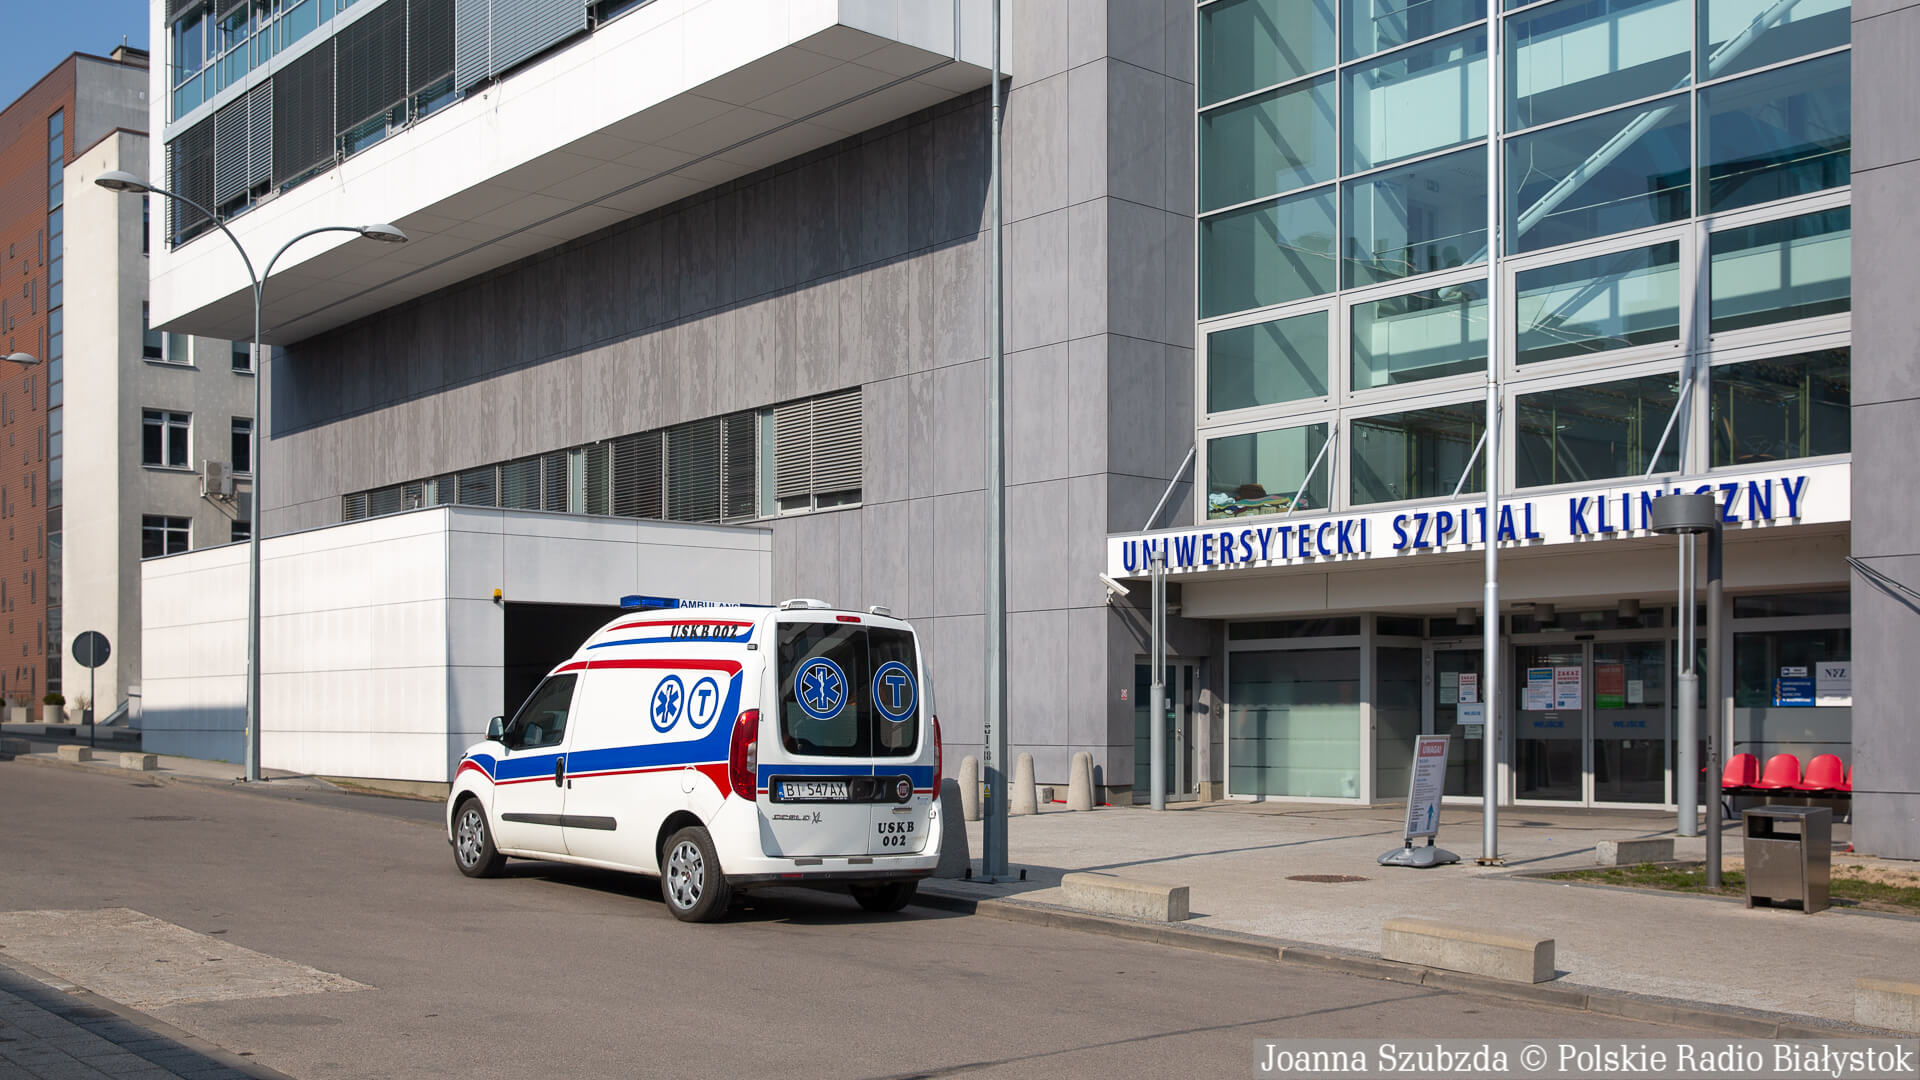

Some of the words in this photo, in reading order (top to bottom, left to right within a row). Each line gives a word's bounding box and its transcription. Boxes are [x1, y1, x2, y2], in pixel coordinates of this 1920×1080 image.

[1123, 517, 1366, 572] UNIWERSYTECKI
[1393, 502, 1540, 550] SZPITAL
[1569, 476, 1805, 535] KLINZNY
[670, 624, 710, 640] USKB
[712, 624, 738, 639] 002
[886, 675, 906, 708] T
[698, 689, 711, 716] T
[807, 783, 845, 797] 547AX
[878, 821, 915, 834] USKB
[882, 835, 906, 847] 002
